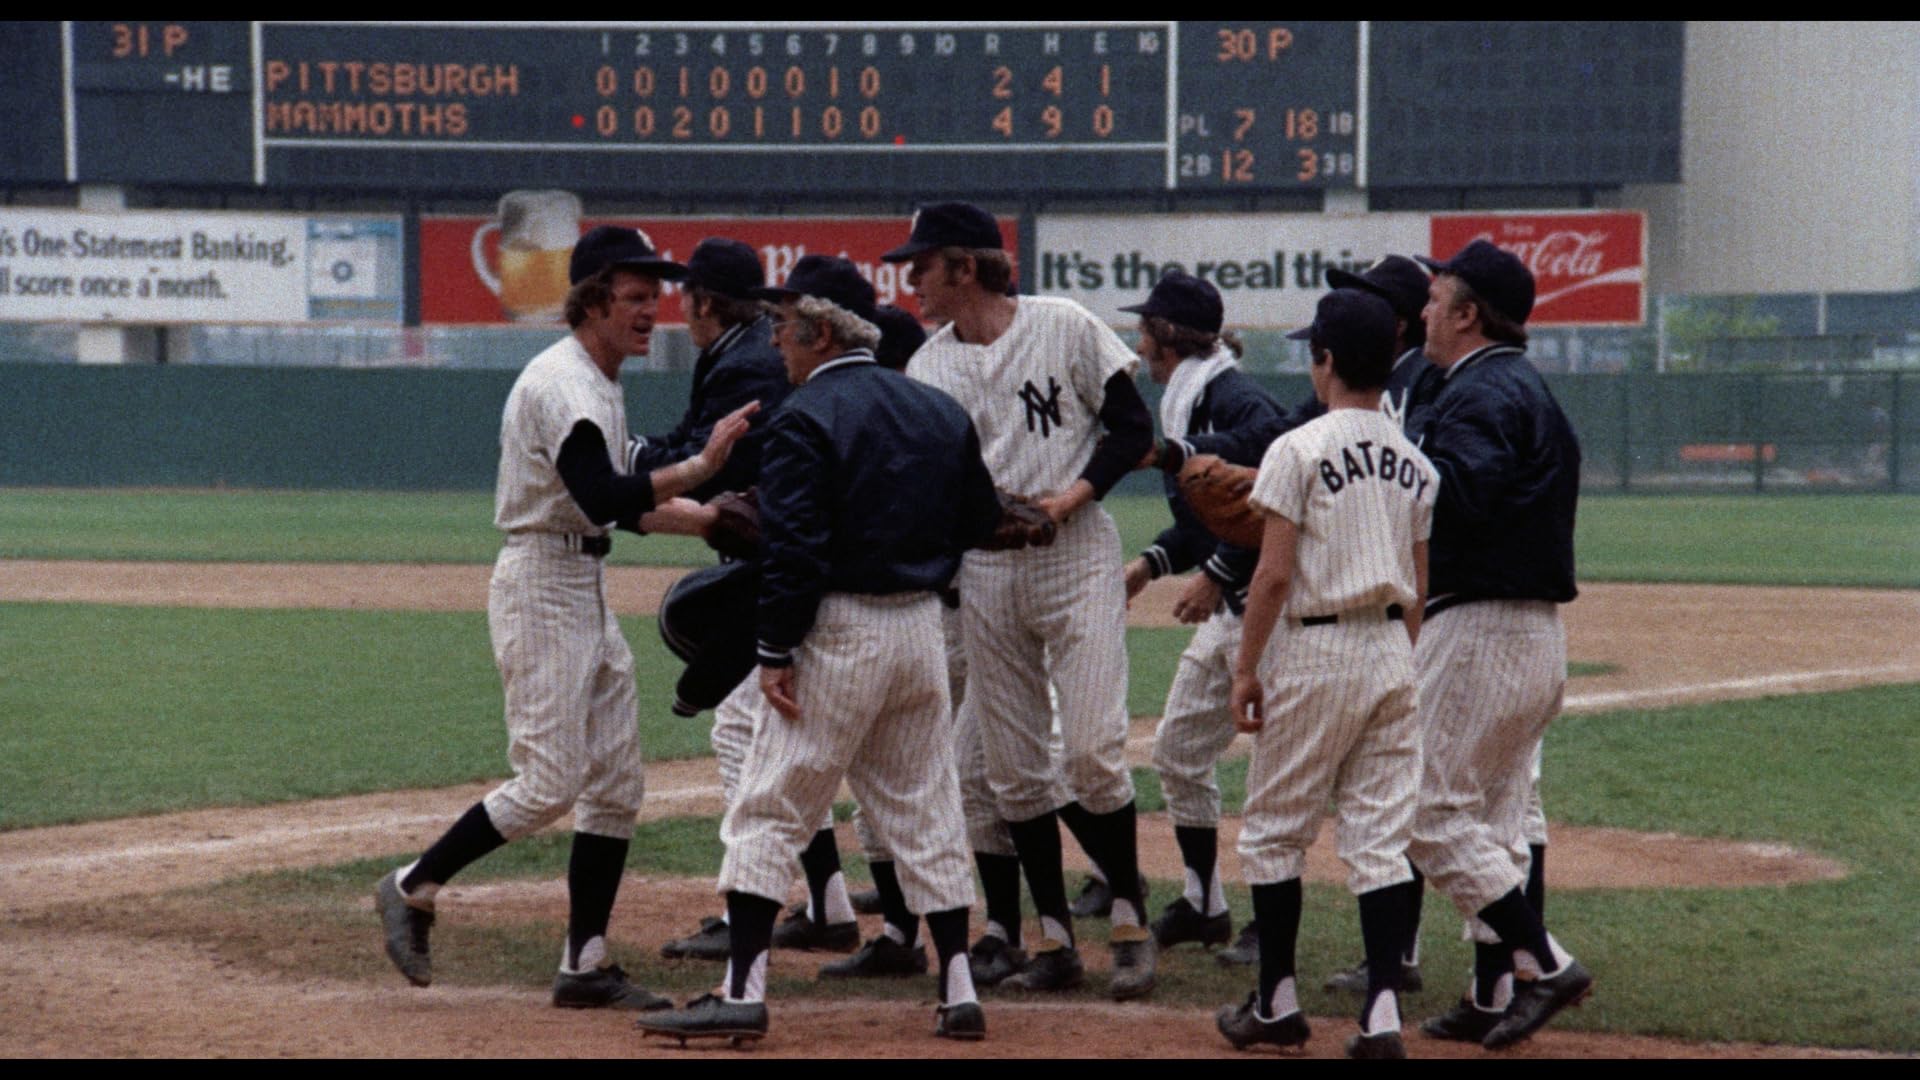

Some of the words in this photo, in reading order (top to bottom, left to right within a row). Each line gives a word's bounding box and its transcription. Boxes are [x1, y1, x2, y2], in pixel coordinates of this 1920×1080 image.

[164, 24, 189, 57] P
[636, 33, 650, 54] 2
[675, 33, 688, 54] 3
[711, 33, 726, 54] 4
[750, 33, 763, 54] 5
[787, 33, 800, 54] 6
[825, 33, 839, 54] 7
[863, 33, 877, 54] 8
[901, 33, 915, 54] 9
[1045, 33, 1060, 54] H
[1095, 33, 1108, 54] E
[1217, 28, 1257, 62] 30
[1268, 28, 1294, 61] P
[265, 61, 519, 97] PITTSBURGH
[597, 66, 617, 98] 0
[635, 66, 655, 98] 0
[679, 66, 689, 98] 1
[709, 66, 730, 98] 0
[747, 66, 768, 98] 0
[785, 66, 805, 98] 0
[829, 66, 840, 98] 1
[860, 66, 880, 98] 0
[992, 65, 1013, 98] 2
[1042, 65, 1063, 97] 4
[265, 102, 469, 136] MAMMOTHS
[597, 106, 617, 138] 0
[635, 106, 655, 138] 0
[672, 106, 692, 138] 2
[709, 106, 730, 138] 0
[754, 106, 764, 138] 1
[791, 106, 801, 138] 1
[823, 106, 843, 138] 0
[860, 106, 880, 138] 0
[992, 106, 1013, 138] 4
[1041, 105, 1063, 138] 9
[1093, 104, 1114, 137] 0
[1234, 107, 1256, 141] 7
[1285, 107, 1319, 140] 18
[1222, 149, 1254, 181] 12
[1297, 149, 1318, 181] 3
[191, 231, 295, 267] Banking.
[15, 275, 74, 296] score
[80, 276, 131, 298] once
[138, 278, 150, 298] a
[1042, 251, 1104, 290] It's
[1197, 250, 1284, 290] real
[1319, 440, 1429, 501] BATBOY
